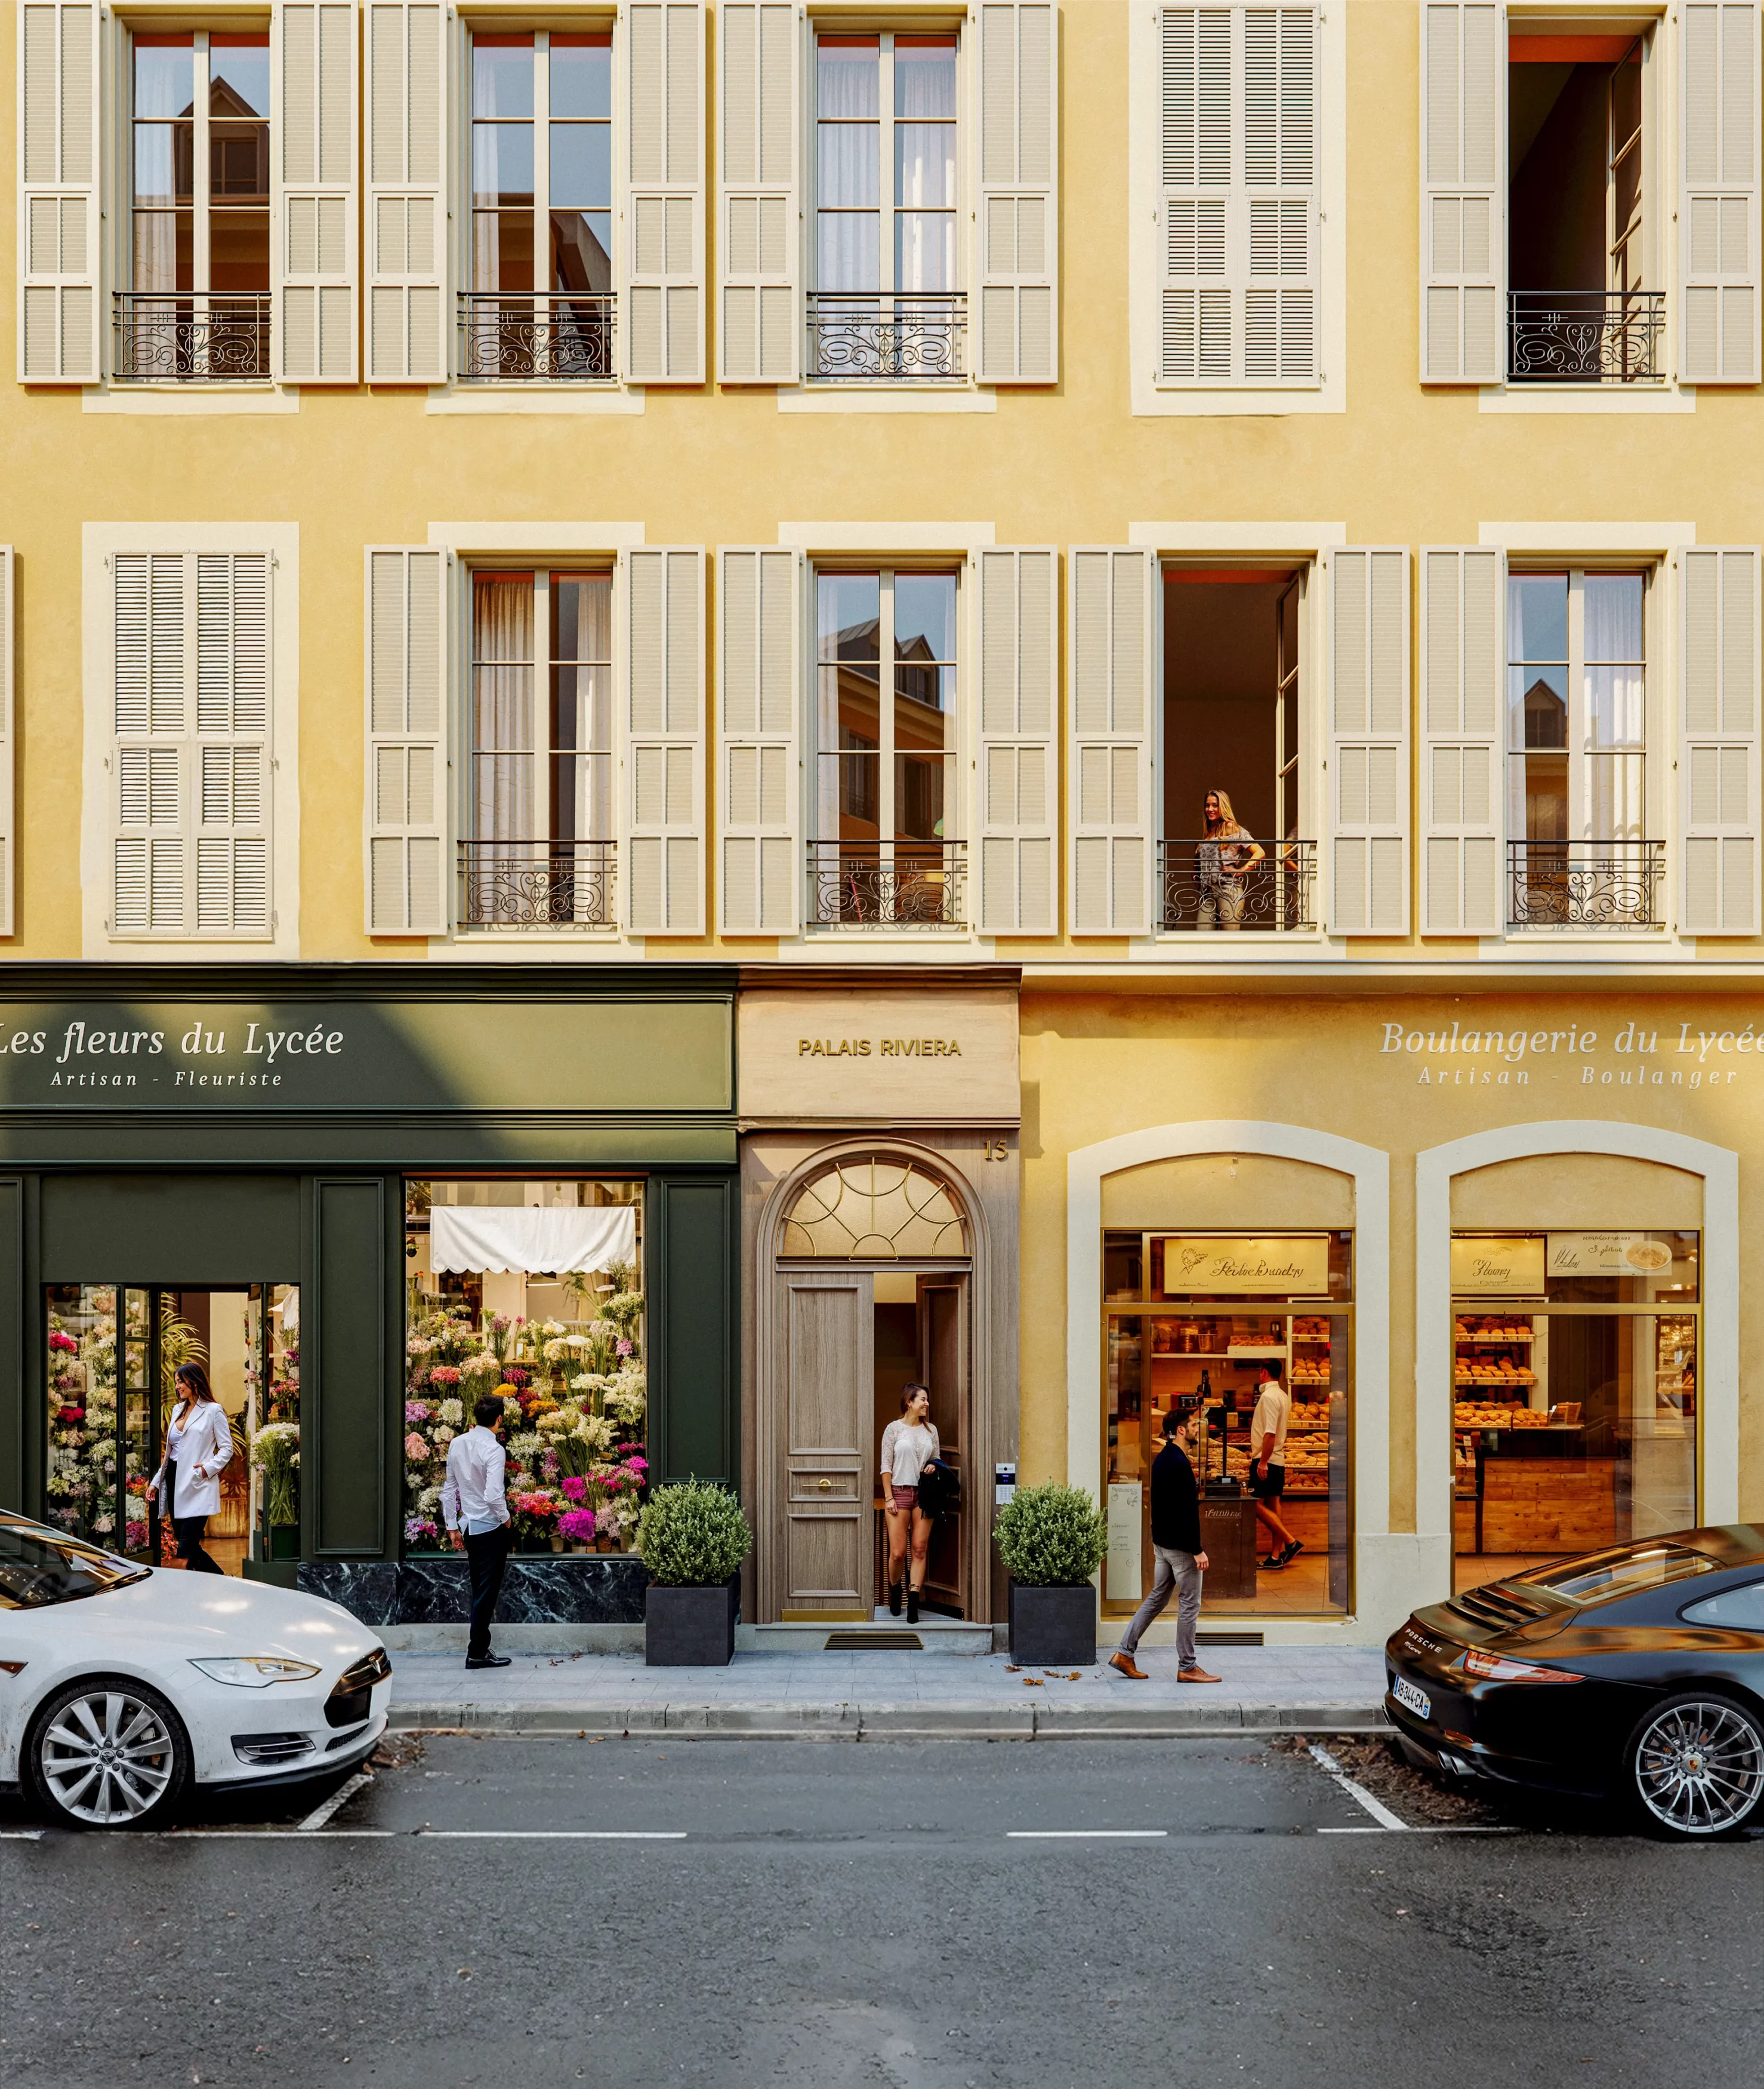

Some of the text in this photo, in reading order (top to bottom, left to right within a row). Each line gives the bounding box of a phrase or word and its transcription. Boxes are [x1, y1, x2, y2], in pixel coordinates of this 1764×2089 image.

[56, 1021, 165, 1064] fleurs
[181, 1022, 226, 1054] du
[242, 1023, 344, 1064] Lycée
[798, 1039, 961, 1055] PALAIS RIVIERA
[1379, 1021, 1598, 1062] Boulangerie
[1614, 1022, 1658, 1053] du
[50, 1071, 137, 1086] Artisan
[174, 1071, 282, 1086] Fleuriste
[1417, 1067, 1529, 1084] Artisan
[1581, 1066, 1738, 1090] Boulanger
[984, 1140, 1007, 1160] 15
[1405, 1628, 1443, 1653] PORSCHE
[1397, 1681, 1424, 1711] AB-344-CA
